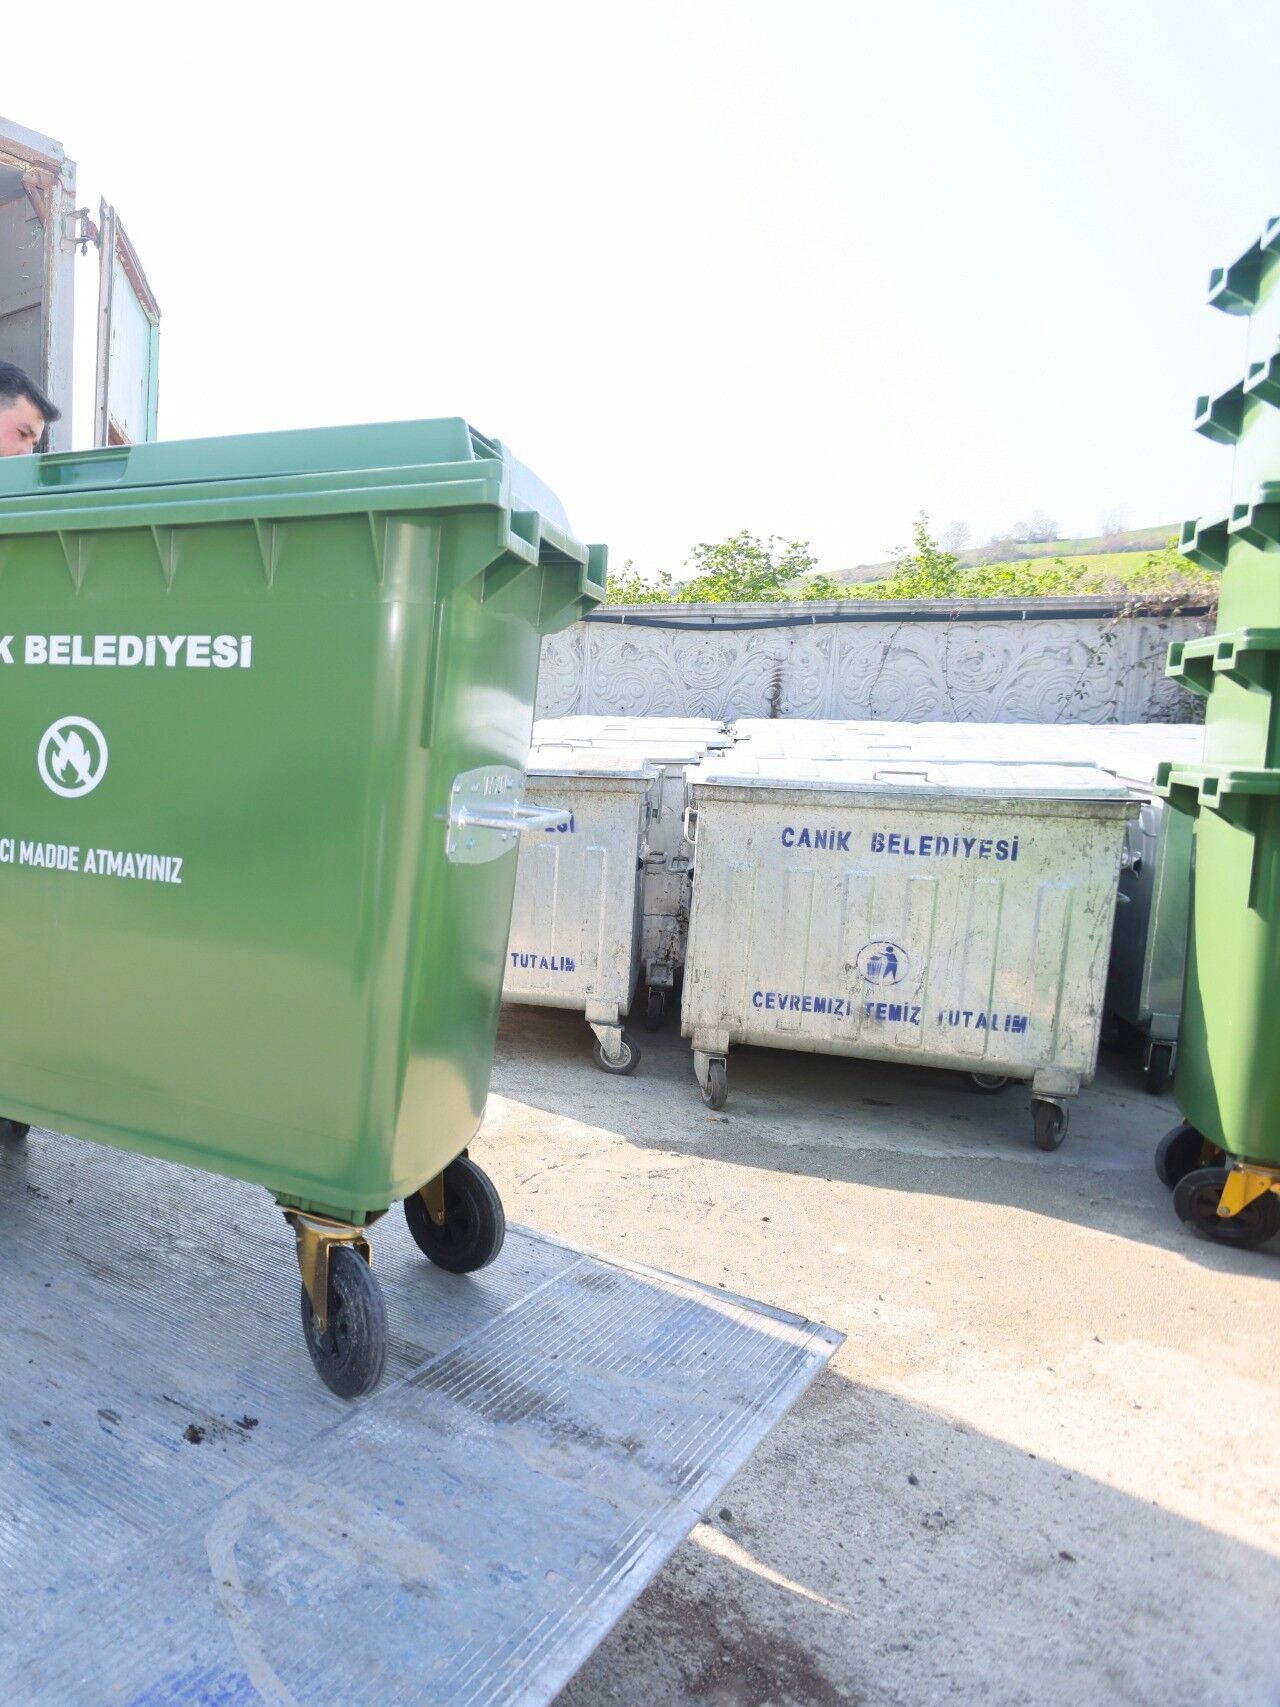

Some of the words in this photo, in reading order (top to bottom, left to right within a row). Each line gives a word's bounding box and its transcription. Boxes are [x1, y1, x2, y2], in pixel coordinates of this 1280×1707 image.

[781, 827, 852, 851] CANİK
[870, 832, 1019, 861] BELEDİYESİ
[19, 840, 80, 872] MADDE
[83, 848, 183, 884] ATMAYINIZ
[511, 952, 575, 972] TUTALIM
